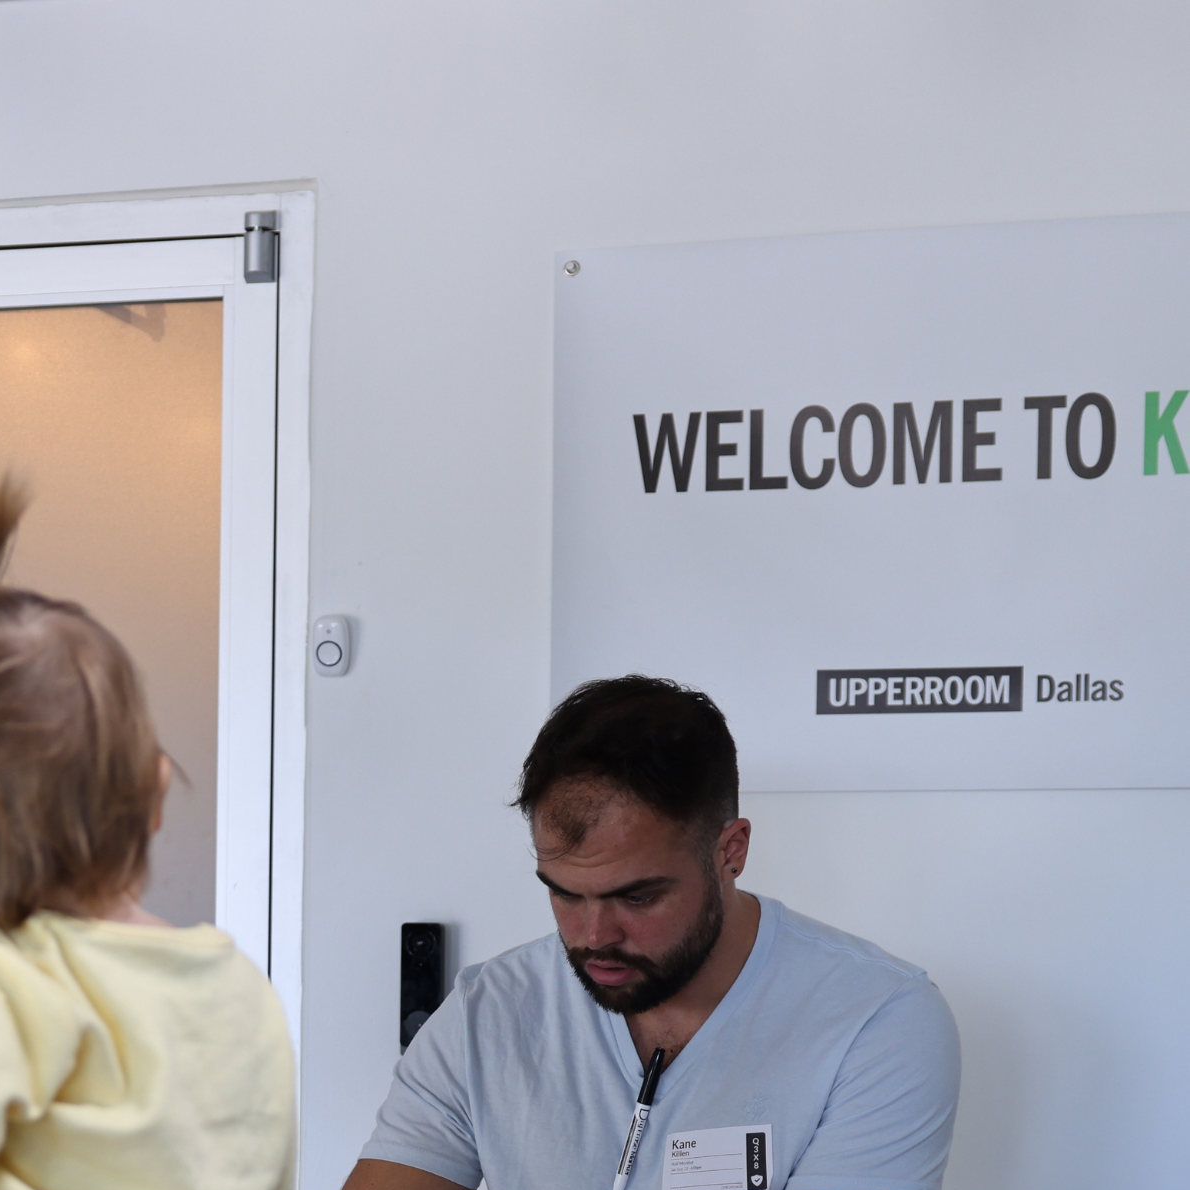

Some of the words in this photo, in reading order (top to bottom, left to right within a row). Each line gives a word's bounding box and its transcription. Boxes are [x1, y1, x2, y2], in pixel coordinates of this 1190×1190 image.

[632, 397, 1003, 494] WELCOME
[1023, 391, 1117, 480] TO
[828, 674, 1011, 707] UPPERROOM
[1036, 673, 1125, 703] Dallas
[671, 1150, 690, 1158] Killen
[672, 1139, 697, 1150] Kane
